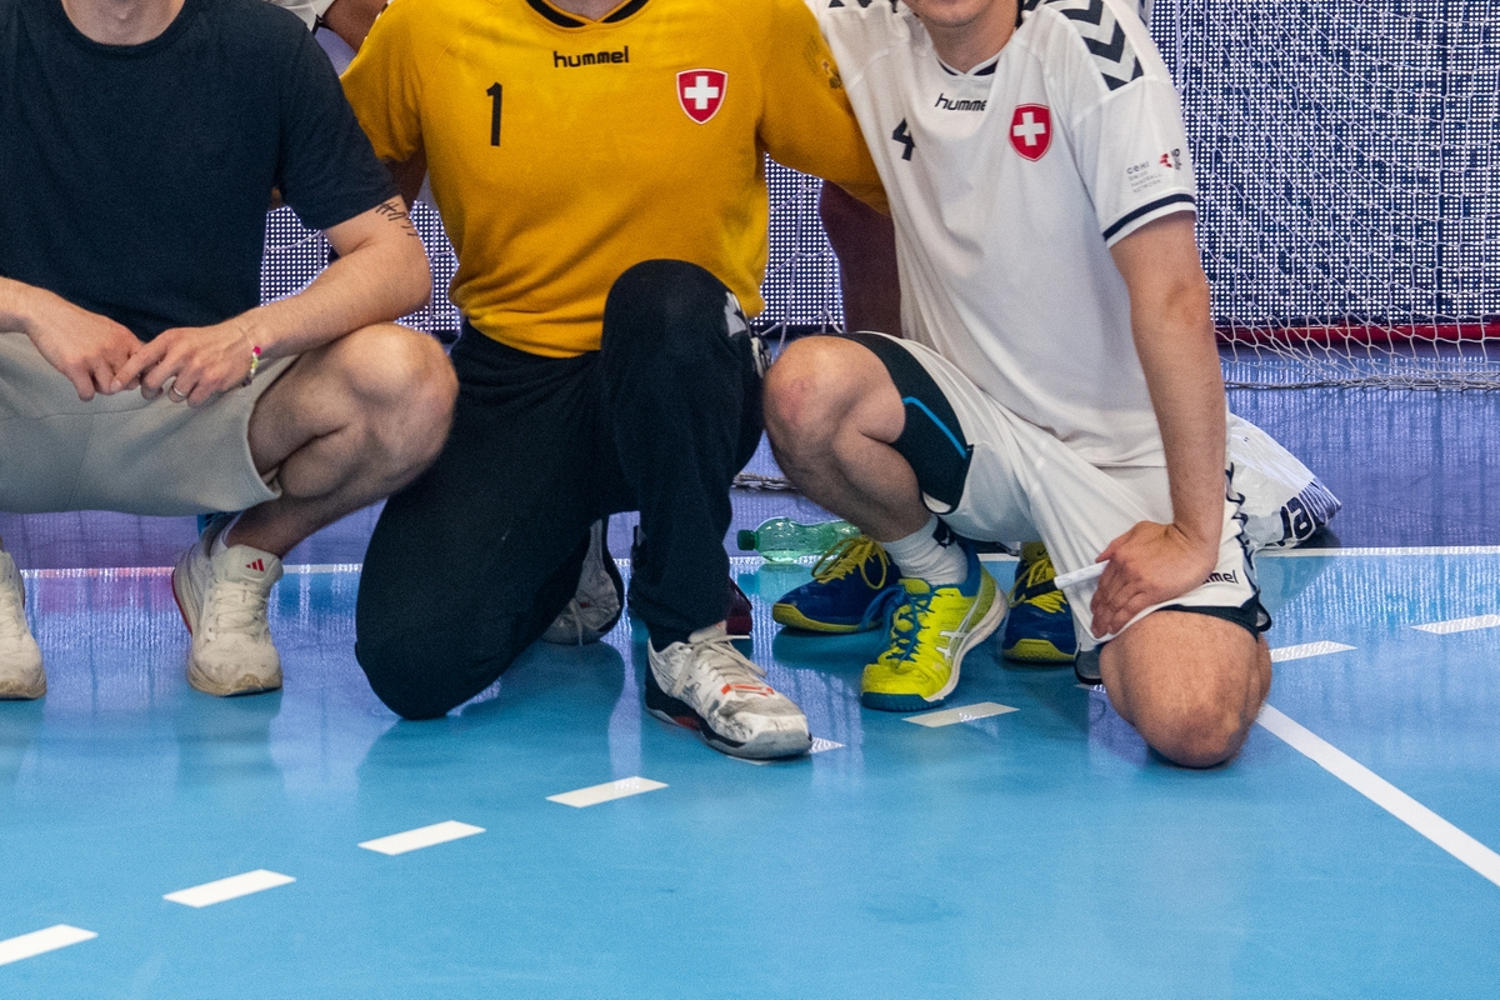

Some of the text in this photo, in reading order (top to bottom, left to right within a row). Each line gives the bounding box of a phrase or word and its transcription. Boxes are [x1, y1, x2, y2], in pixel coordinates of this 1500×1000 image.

[553, 45, 629, 68] hummel
[486, 81, 503, 147] 1
[934, 93, 987, 111] humme
[892, 118, 917, 162] 4
